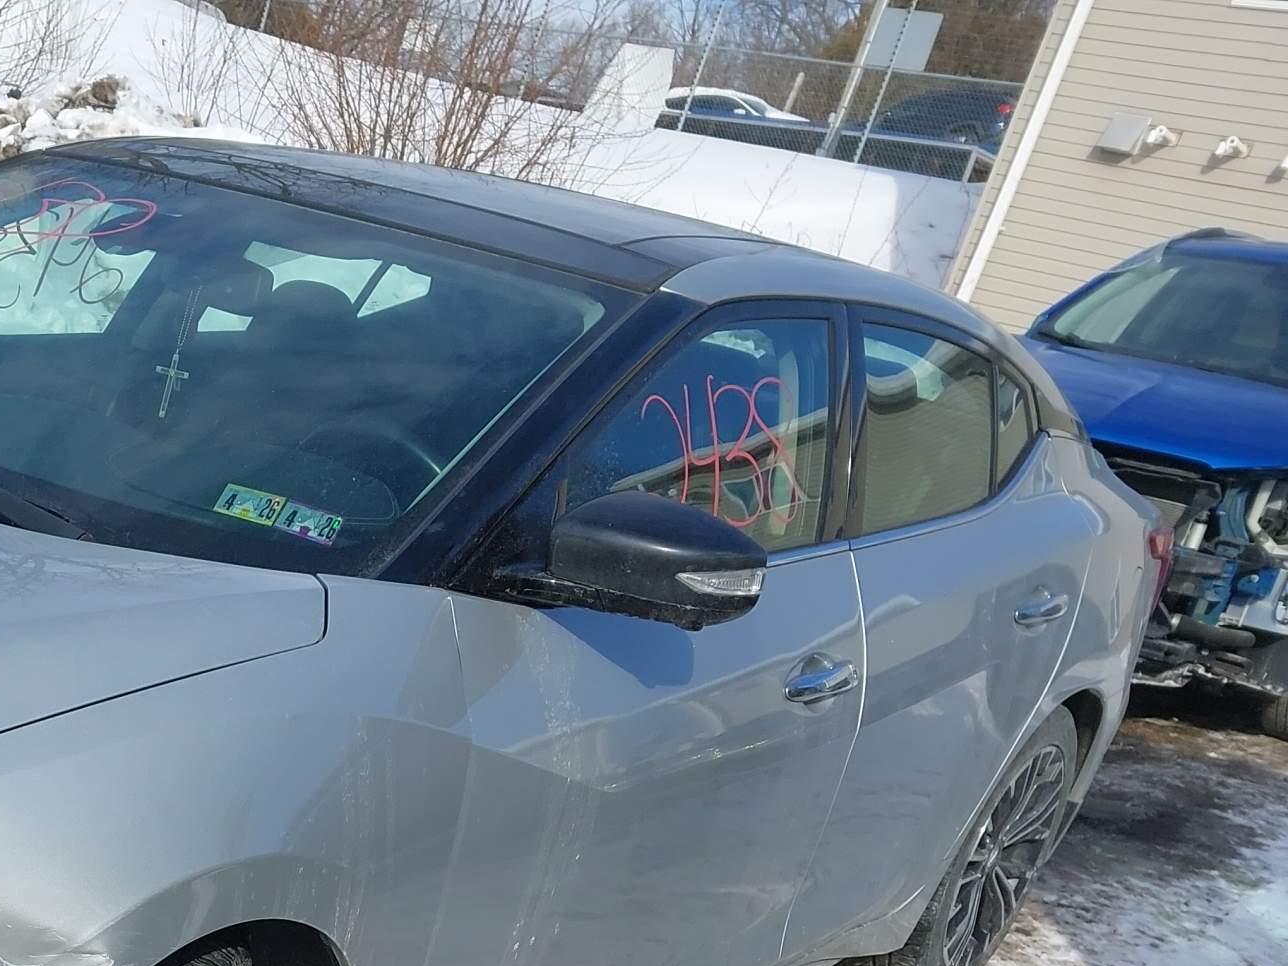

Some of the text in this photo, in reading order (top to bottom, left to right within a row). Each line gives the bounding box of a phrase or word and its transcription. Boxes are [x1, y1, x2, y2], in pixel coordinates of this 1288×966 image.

[223, 493, 281, 521] 4 26
[283, 510, 341, 540] 4 26
